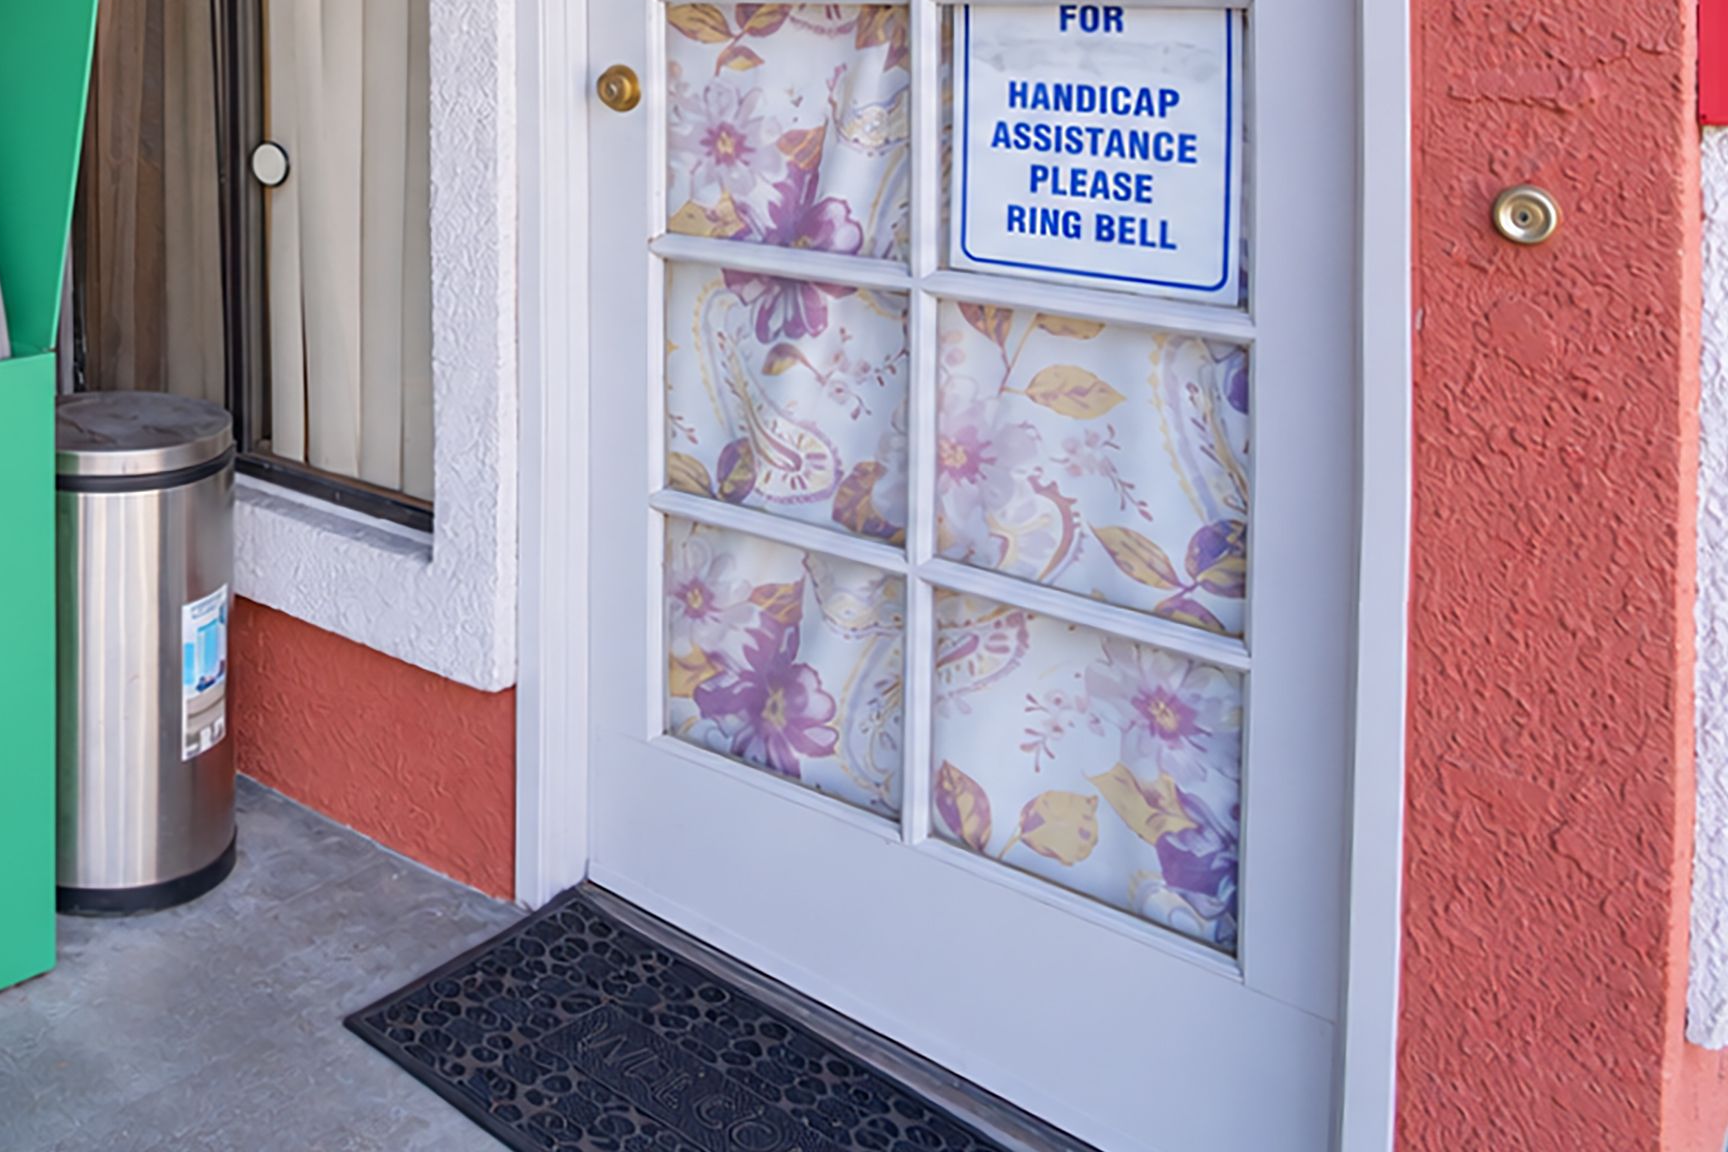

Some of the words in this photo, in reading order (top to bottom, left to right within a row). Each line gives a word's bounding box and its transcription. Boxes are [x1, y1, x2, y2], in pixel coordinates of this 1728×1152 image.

[1058, 5, 1124, 34] FOR
[1008, 80, 1180, 119] HANDICAP
[991, 121, 1198, 164] ASSISTANCE
[1029, 164, 1153, 204] PLEASE
[1007, 204, 1082, 239] RING
[1095, 213, 1177, 251] BELL
